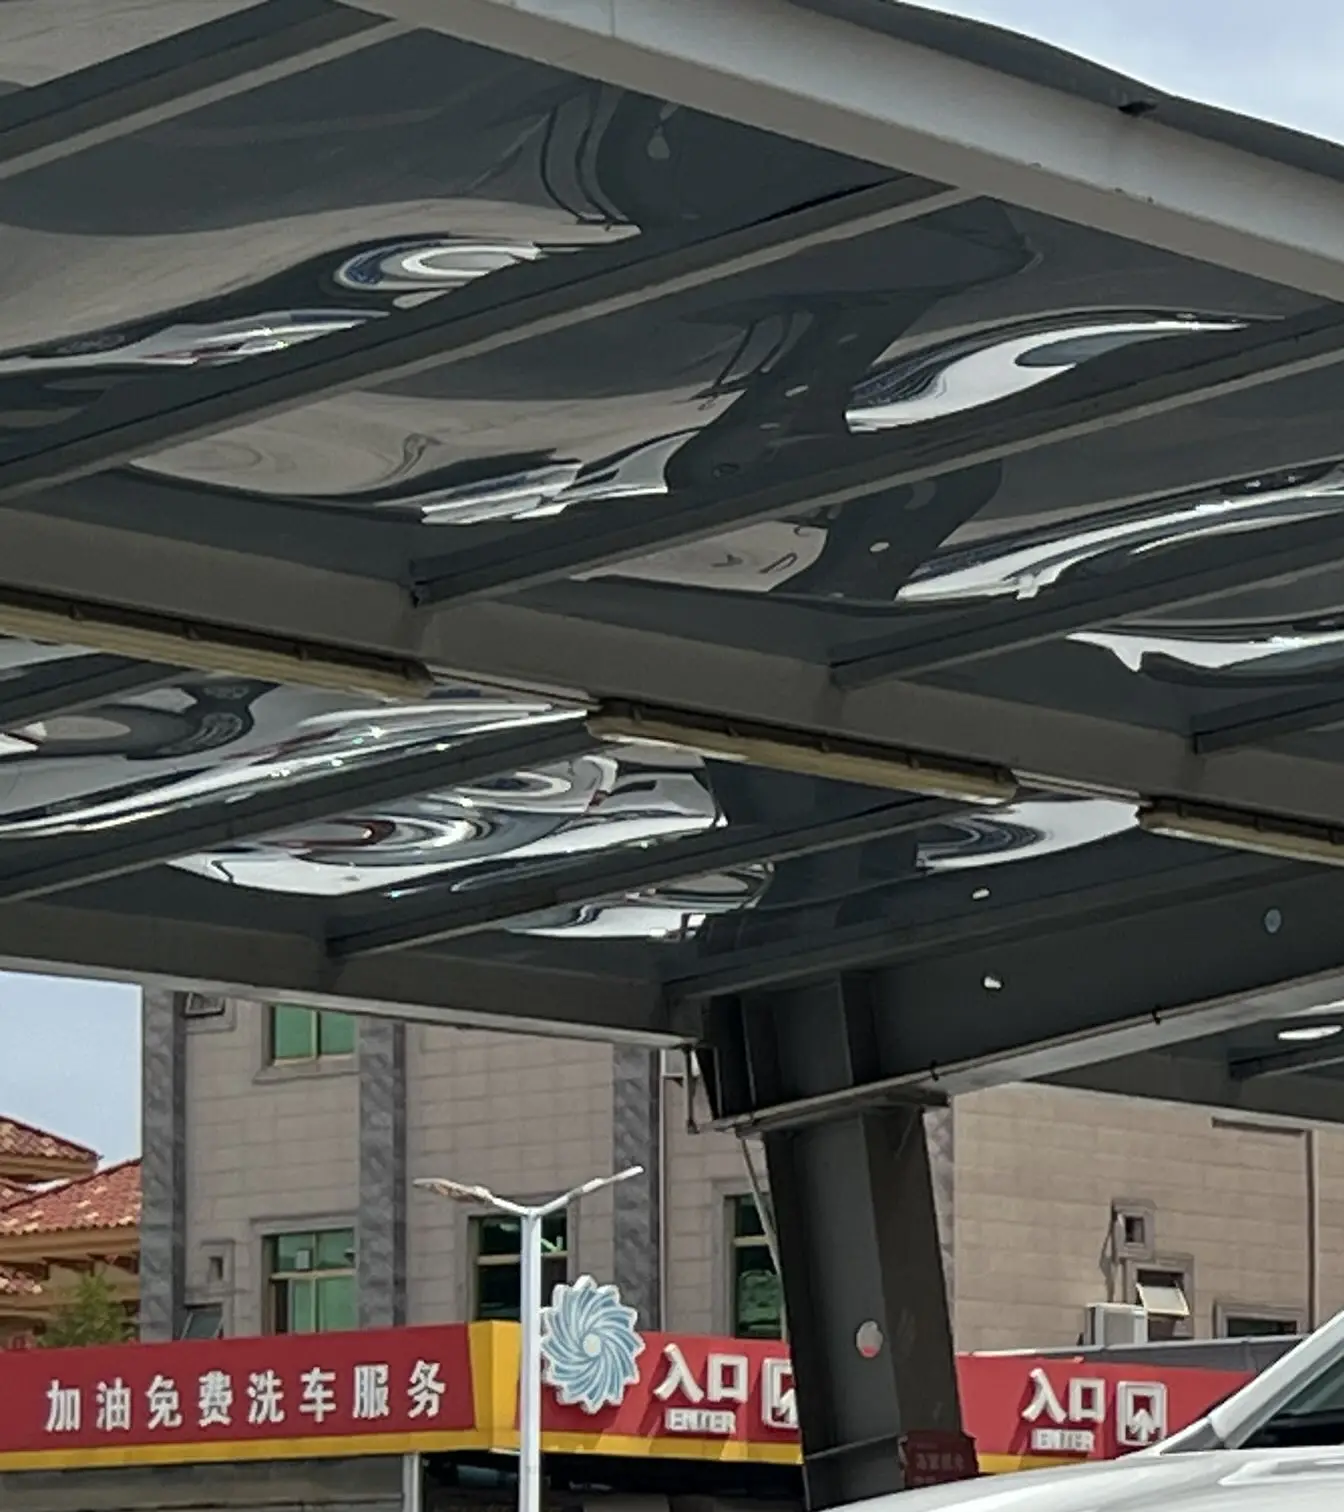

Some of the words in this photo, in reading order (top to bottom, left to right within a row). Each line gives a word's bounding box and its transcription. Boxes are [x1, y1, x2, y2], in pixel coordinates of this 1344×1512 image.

[44, 1358, 447, 1433] 加油免费洗车服务
[652, 1343, 749, 1404] 入口
[1021, 1368, 1106, 1424] 入口
[665, 1407, 737, 1435] ENTER
